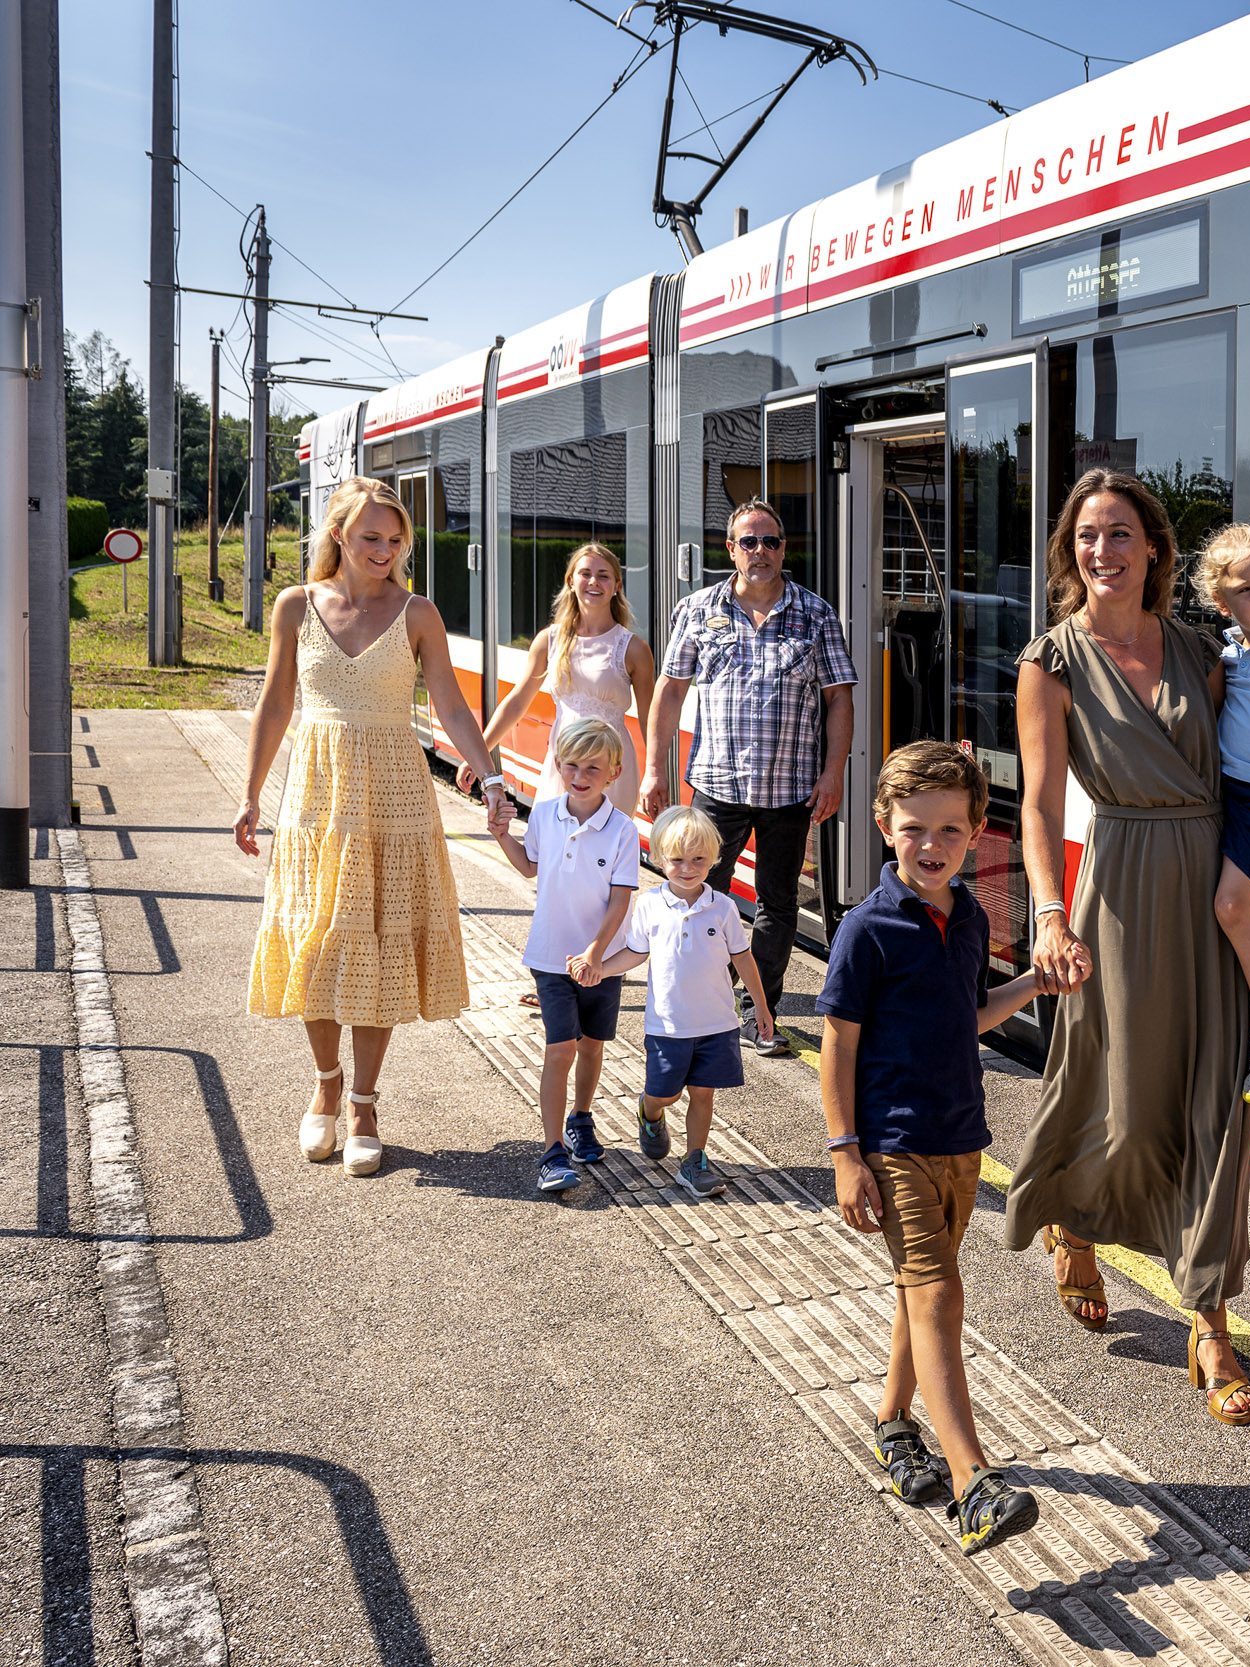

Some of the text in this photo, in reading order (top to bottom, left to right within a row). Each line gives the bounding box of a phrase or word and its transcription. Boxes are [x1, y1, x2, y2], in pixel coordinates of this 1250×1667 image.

[759, 111, 1170, 290] WIR BEWEGEN MENSCHEN
